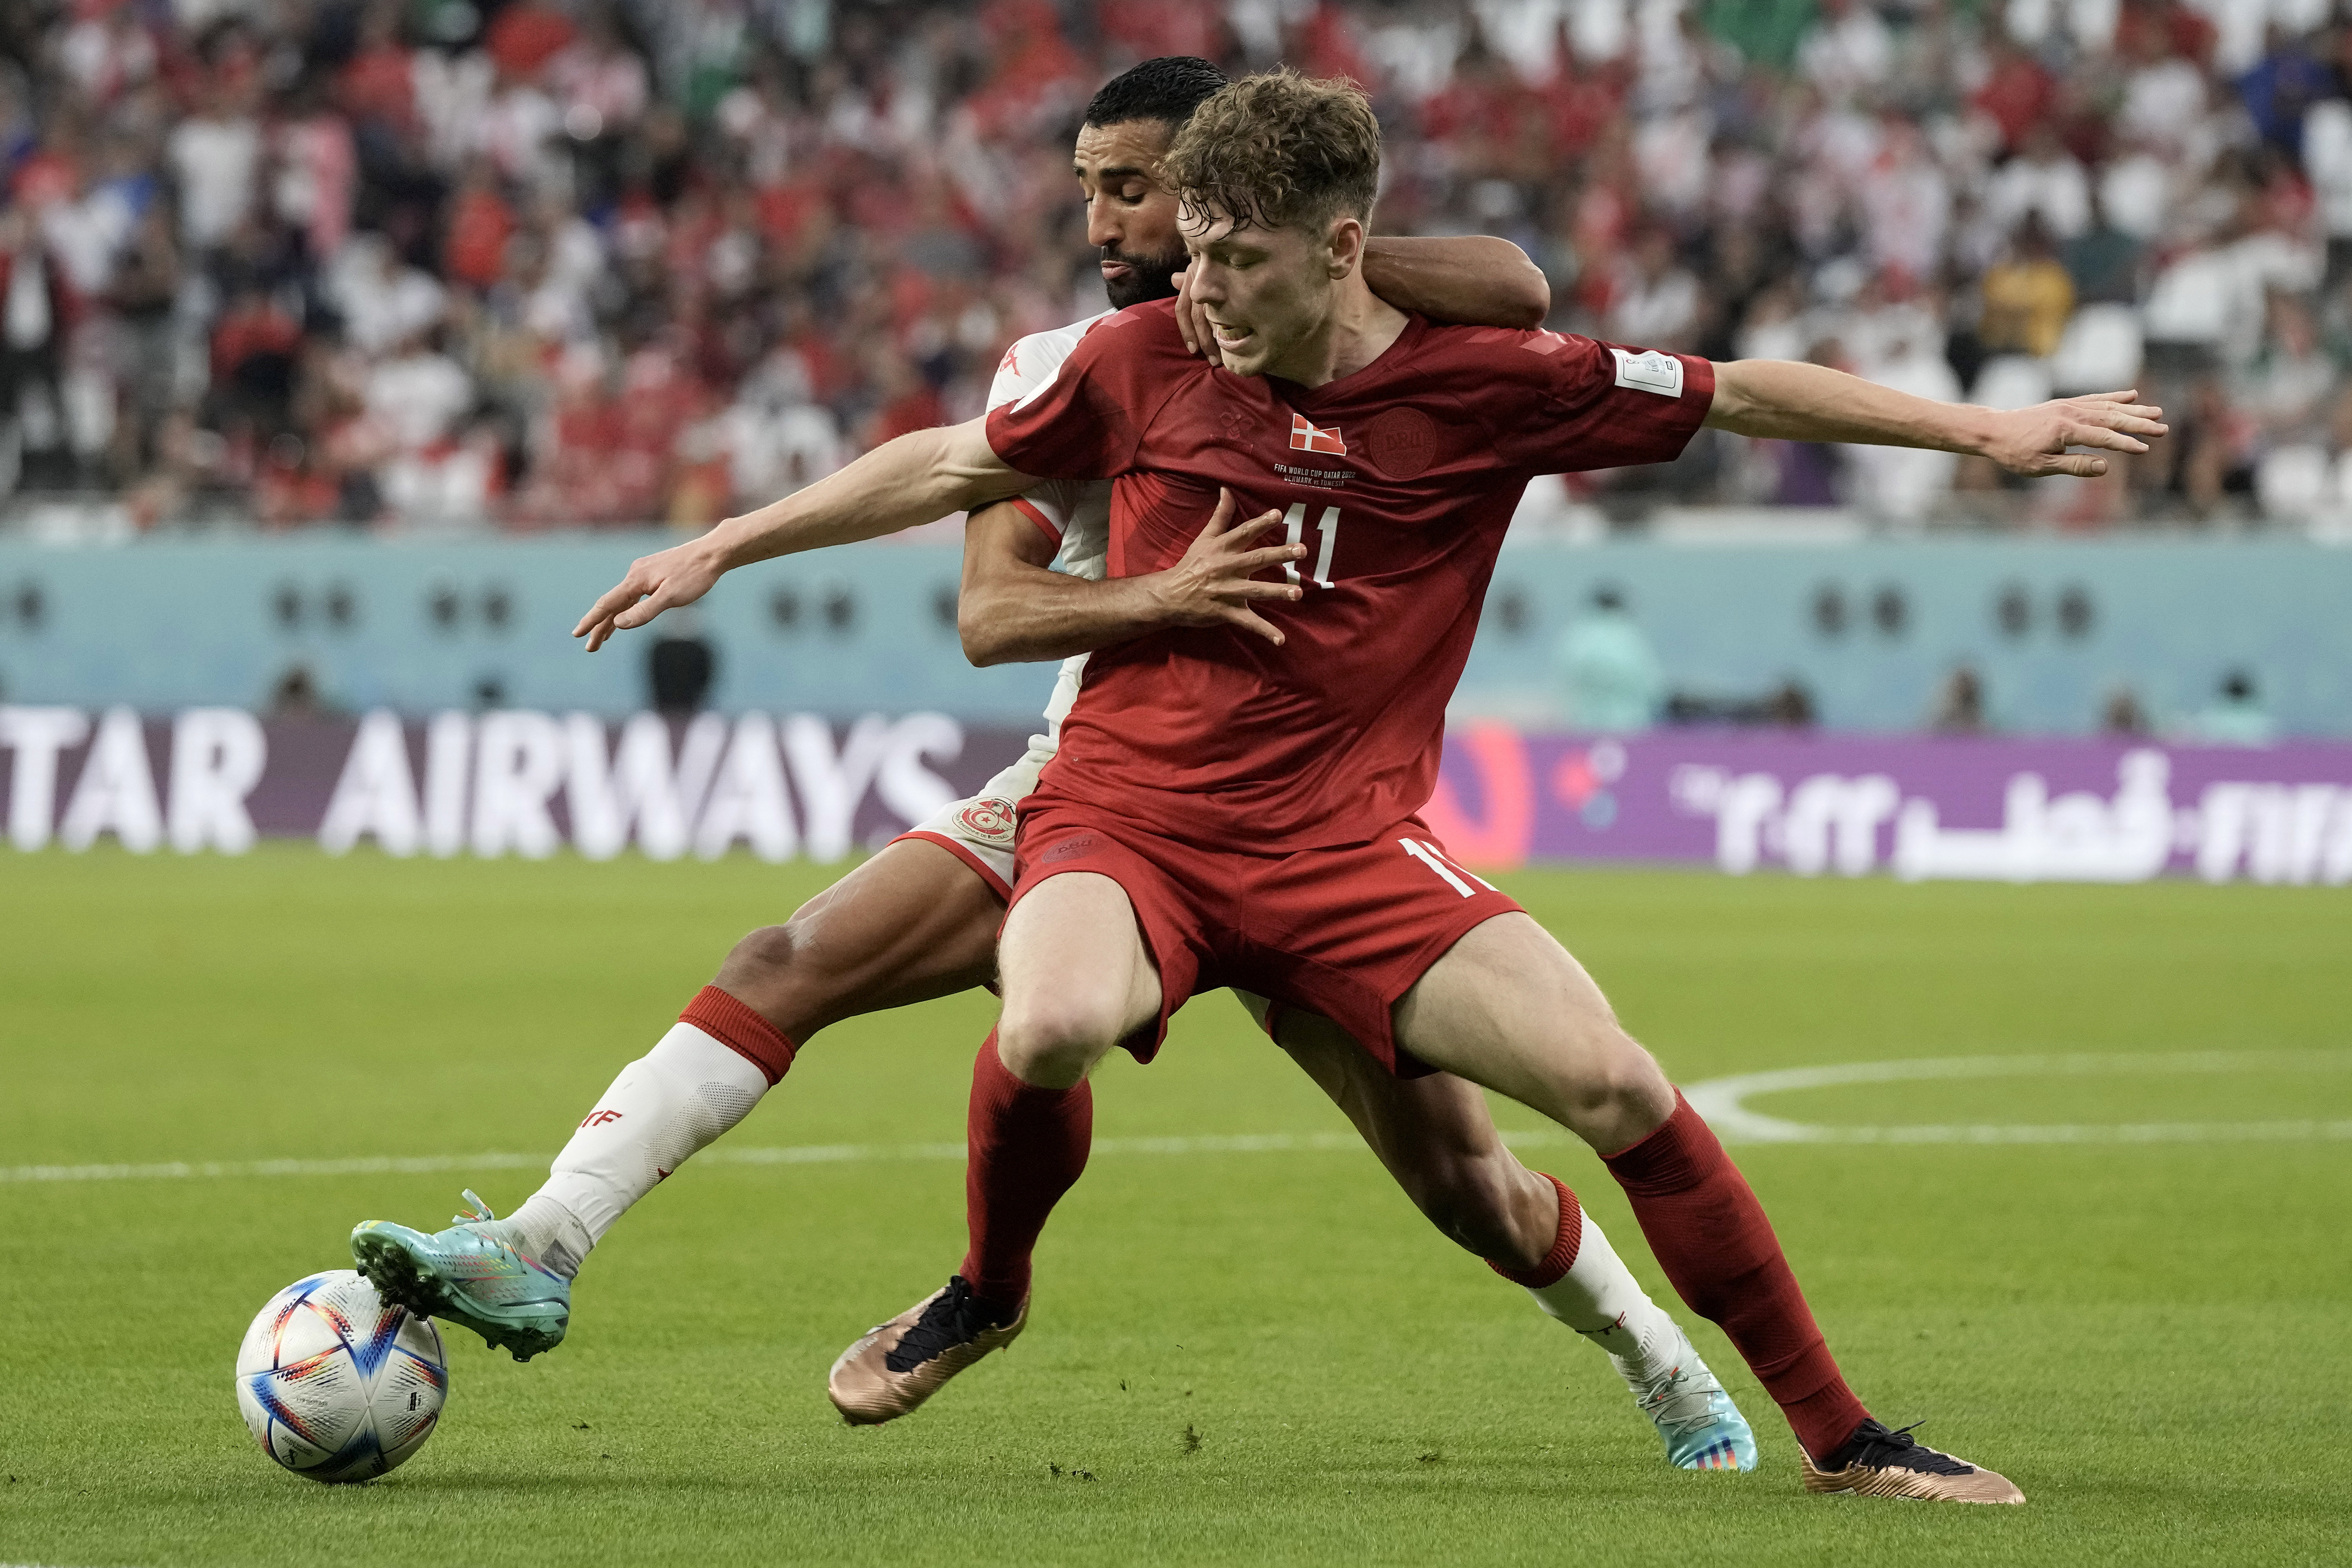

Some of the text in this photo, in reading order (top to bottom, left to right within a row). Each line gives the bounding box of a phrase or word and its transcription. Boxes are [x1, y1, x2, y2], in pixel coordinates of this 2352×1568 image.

[1274, 464, 1287, 473] FIFA
[1289, 466, 1309, 476] WORLD
[1284, 474, 1312, 484] DENMARK
[1282, 503, 1341, 588] 11
[317, 708, 965, 862] AIRWAYS
